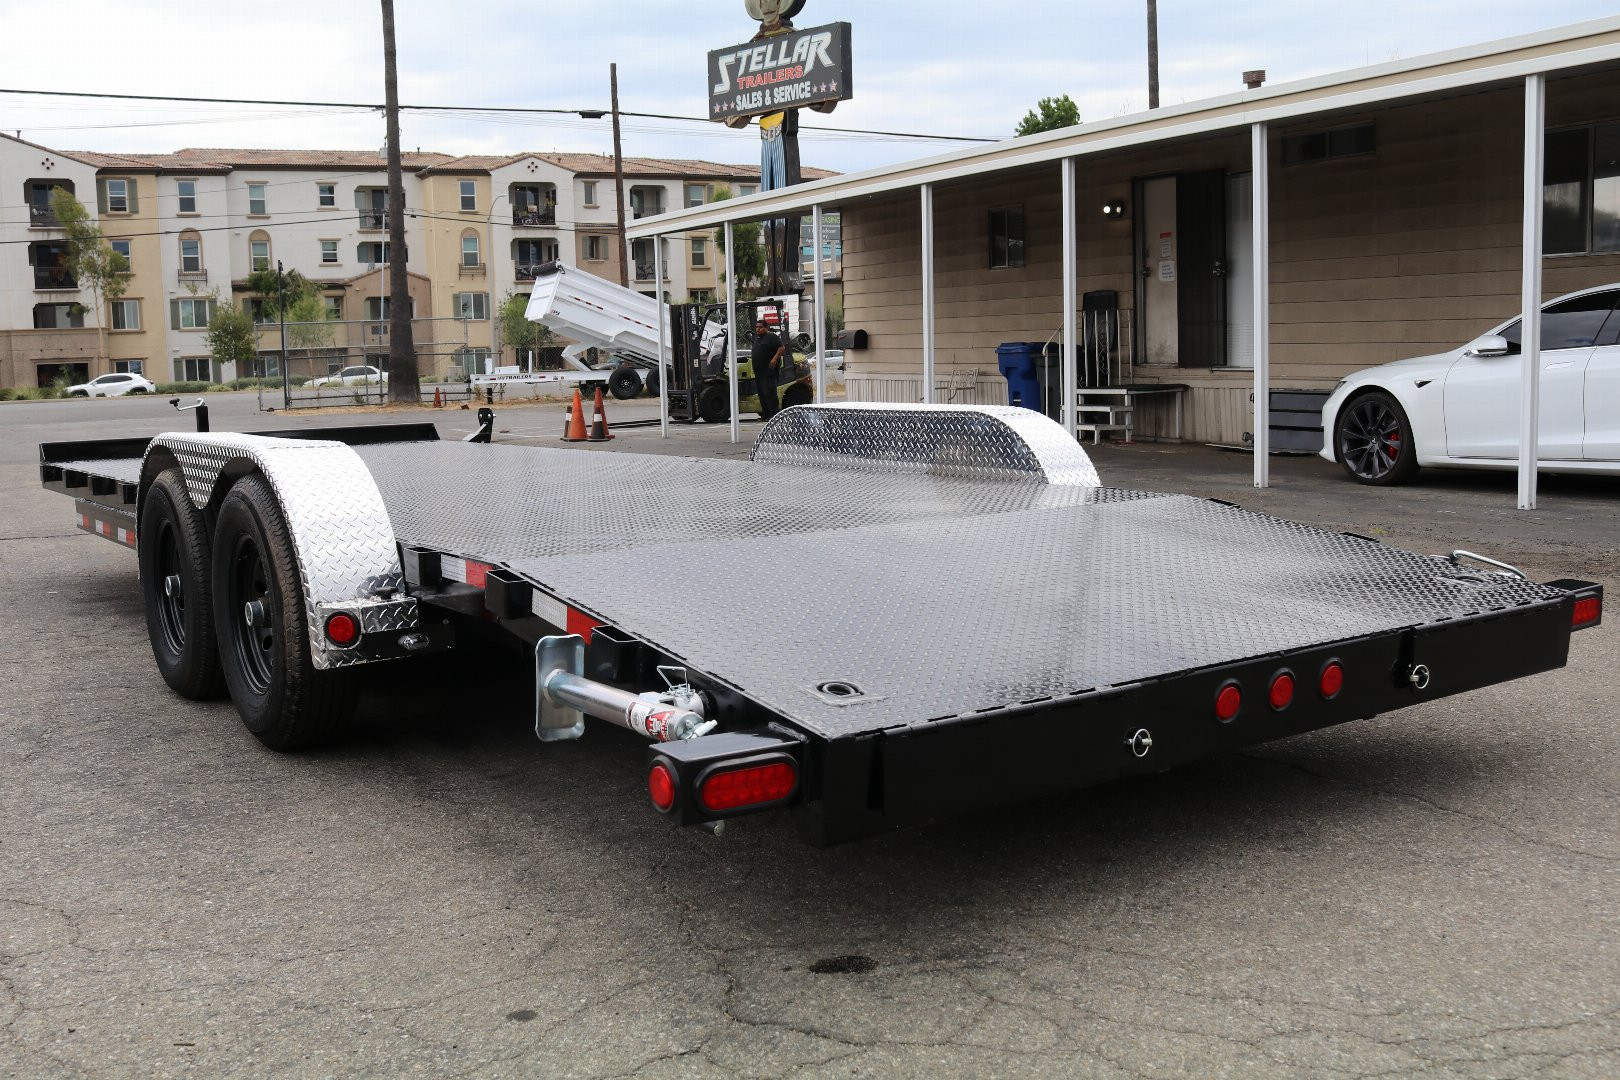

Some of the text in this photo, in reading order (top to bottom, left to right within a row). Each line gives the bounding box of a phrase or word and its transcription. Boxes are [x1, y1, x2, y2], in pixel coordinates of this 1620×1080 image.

[713, 31, 835, 96] STELLAR
[736, 65, 804, 90] TRAILERS
[736, 80, 811, 111] SALES & SERVICE
